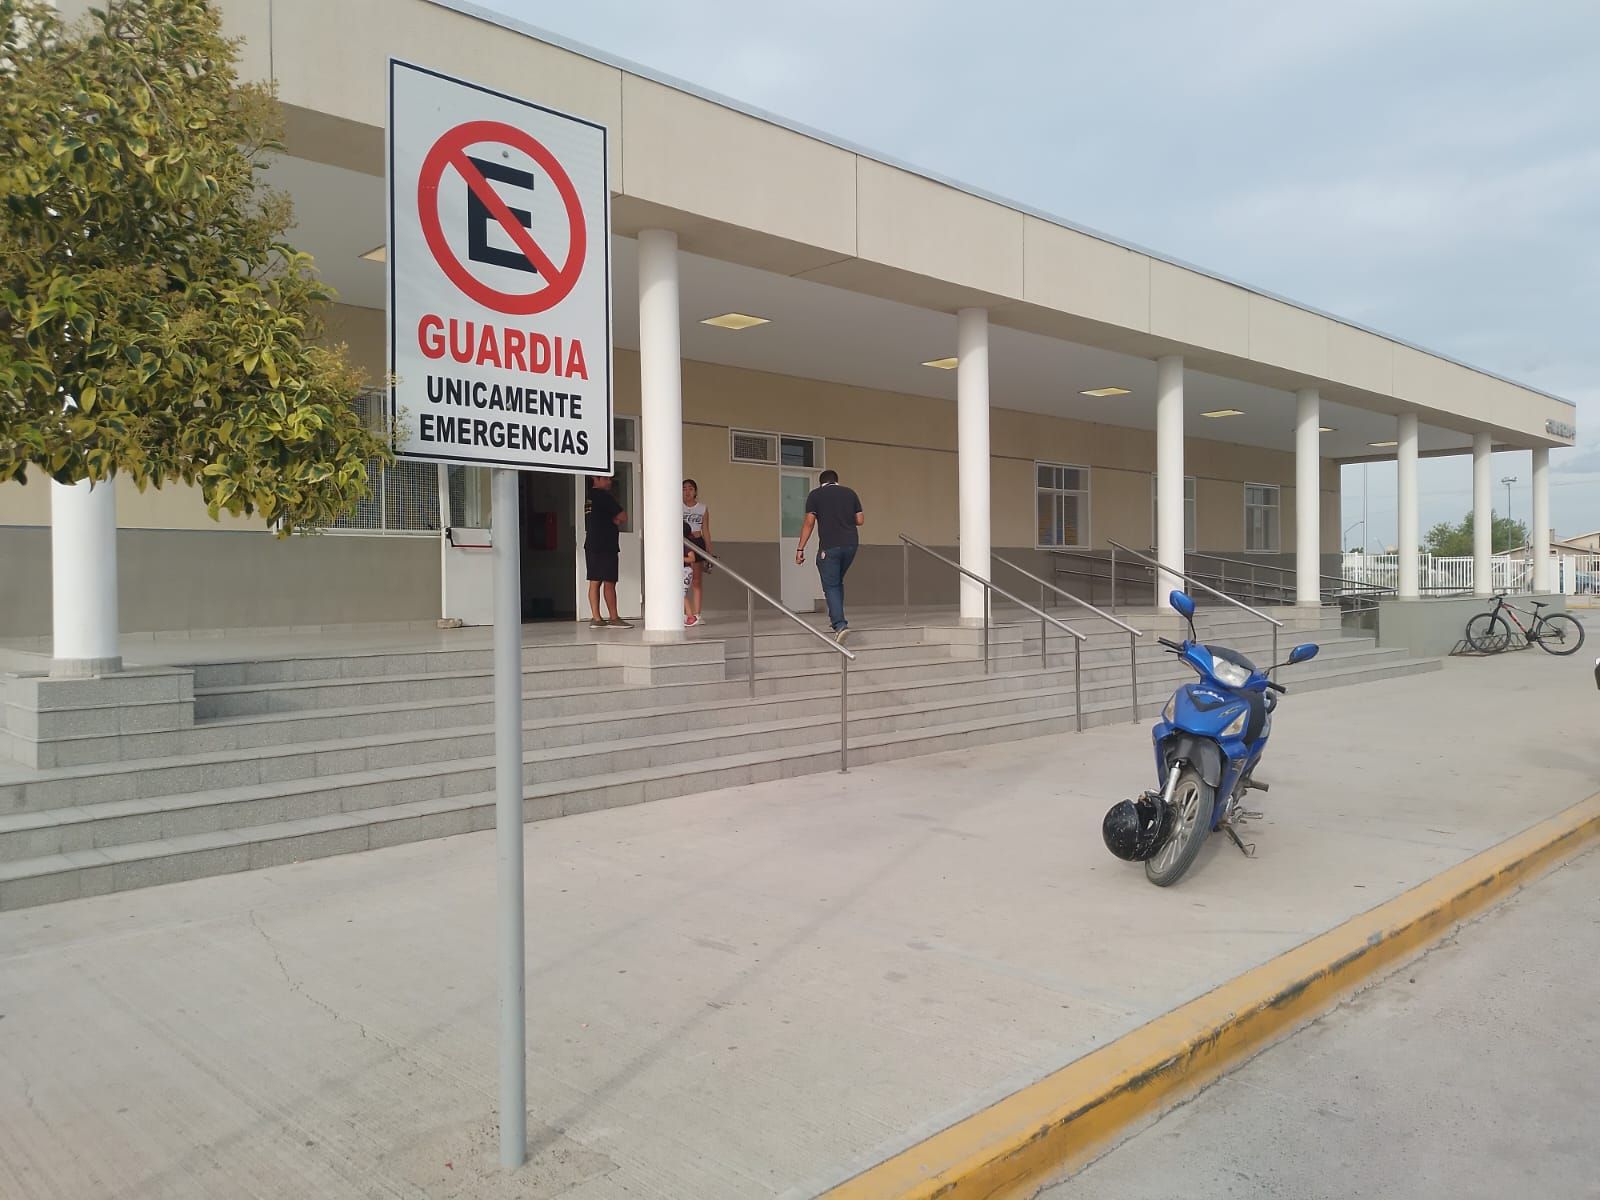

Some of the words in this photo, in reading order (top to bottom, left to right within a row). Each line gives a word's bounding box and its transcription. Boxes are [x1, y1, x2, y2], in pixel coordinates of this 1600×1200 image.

[468, 156, 537, 273] E
[418, 314, 588, 380] GUARDIA
[427, 375, 582, 419] UNICAMENTE
[420, 414, 588, 455] EMERGENCIAS
